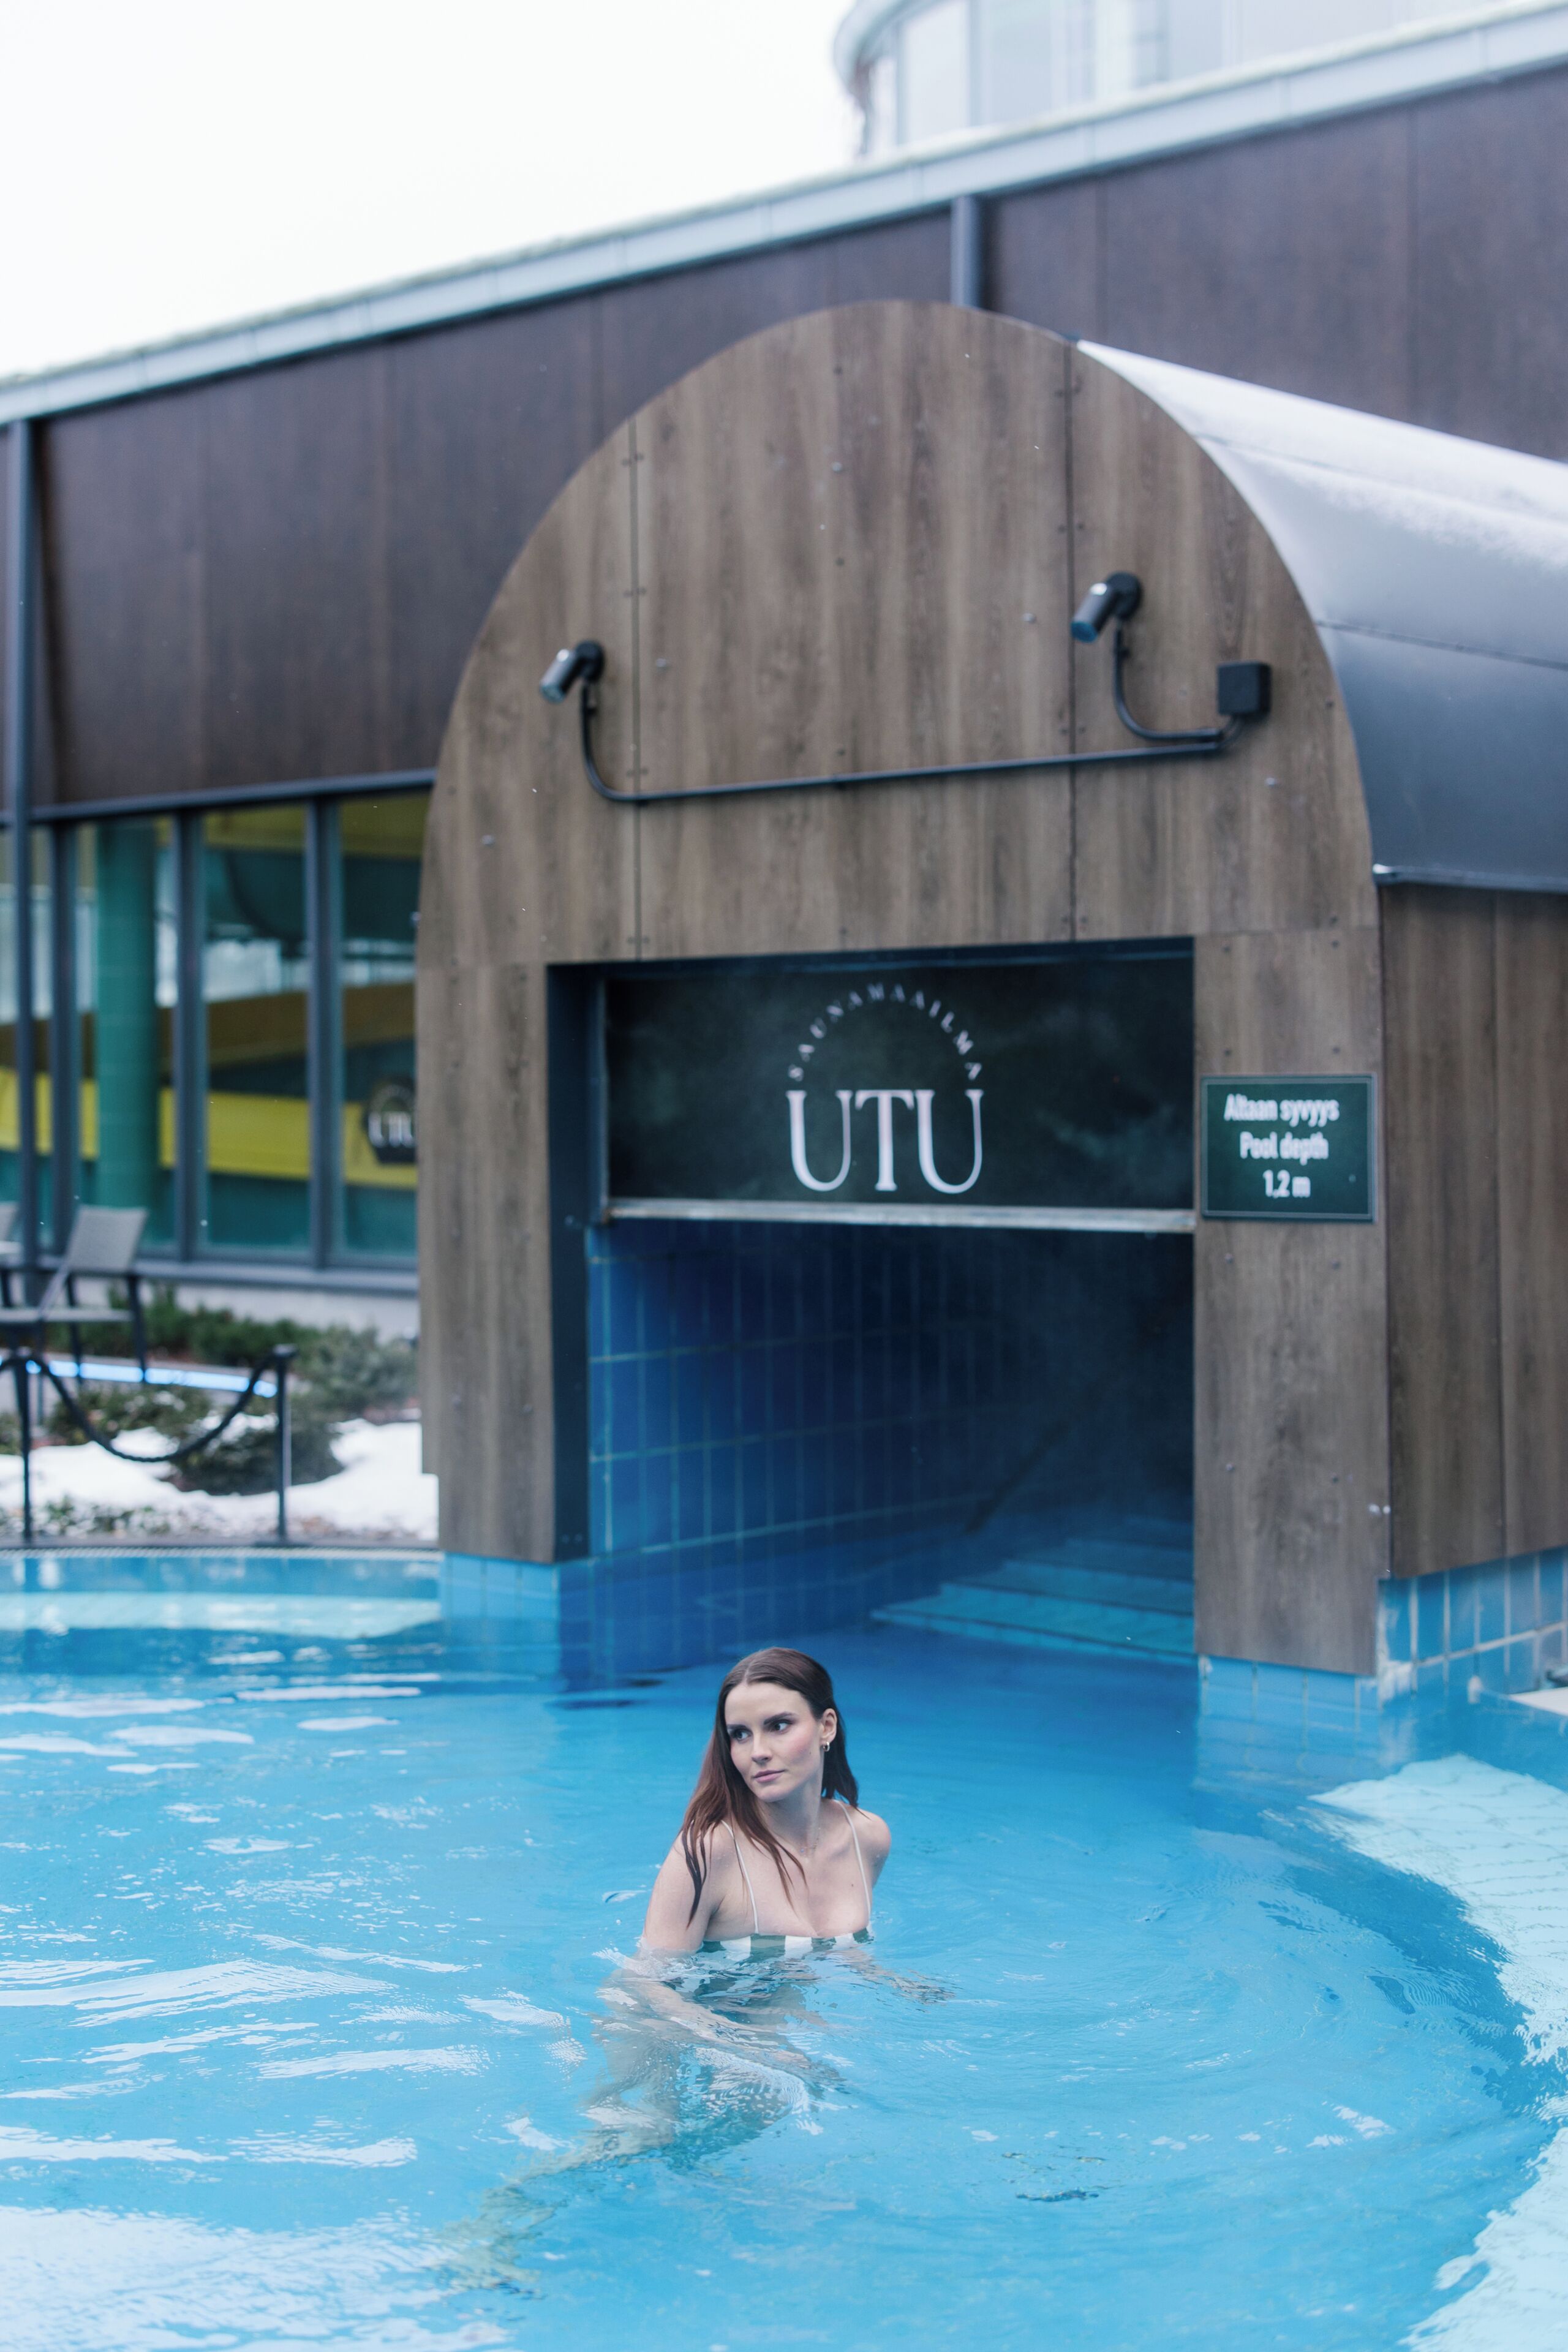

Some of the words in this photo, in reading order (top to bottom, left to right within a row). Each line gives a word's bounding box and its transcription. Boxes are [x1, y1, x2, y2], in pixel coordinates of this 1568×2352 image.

[1223, 1093, 1278, 1121] Altaan
[1280, 1099, 1340, 1127] syvyys
[785, 1088, 984, 1194] UTU
[1239, 1131, 1278, 1159] Pool
[1279, 1131, 1329, 1166] depth
[1292, 1176, 1311, 1197] m
